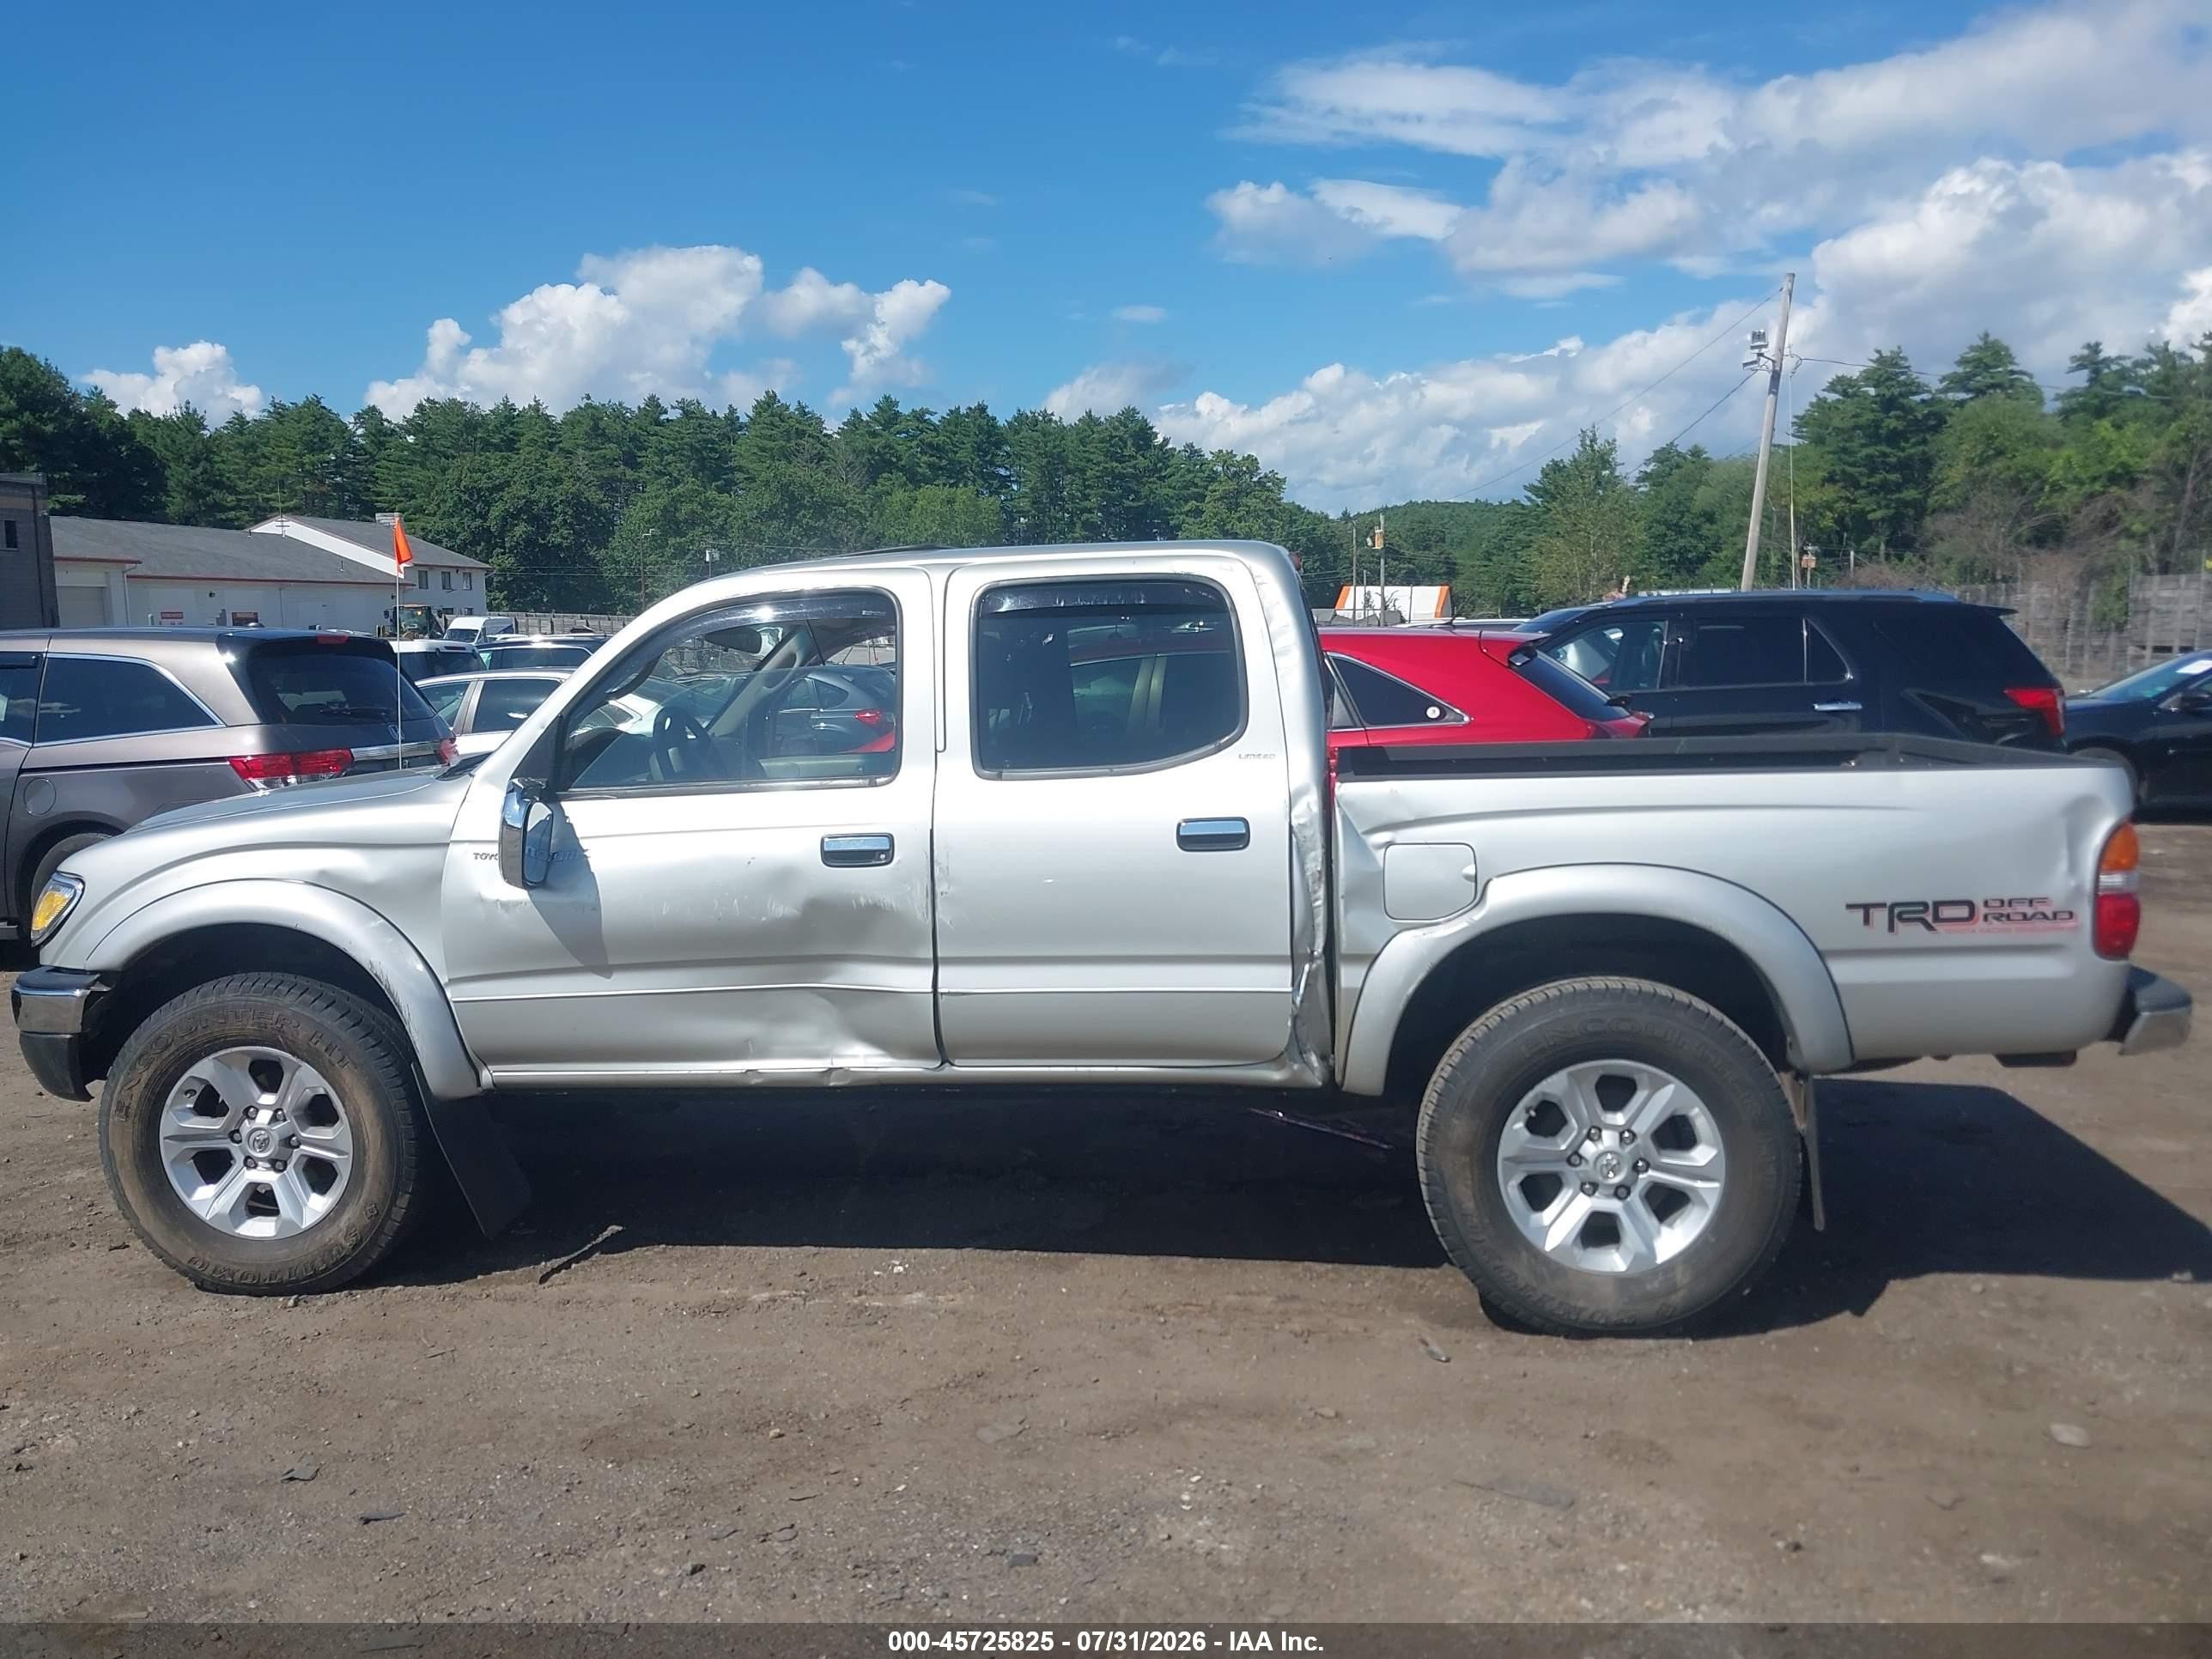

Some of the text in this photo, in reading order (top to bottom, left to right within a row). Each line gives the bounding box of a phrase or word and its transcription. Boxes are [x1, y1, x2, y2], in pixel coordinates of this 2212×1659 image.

[1983, 896, 2050, 908] OFF
[1845, 899, 1978, 933] TRD
[1983, 910, 2074, 922] ROAD
